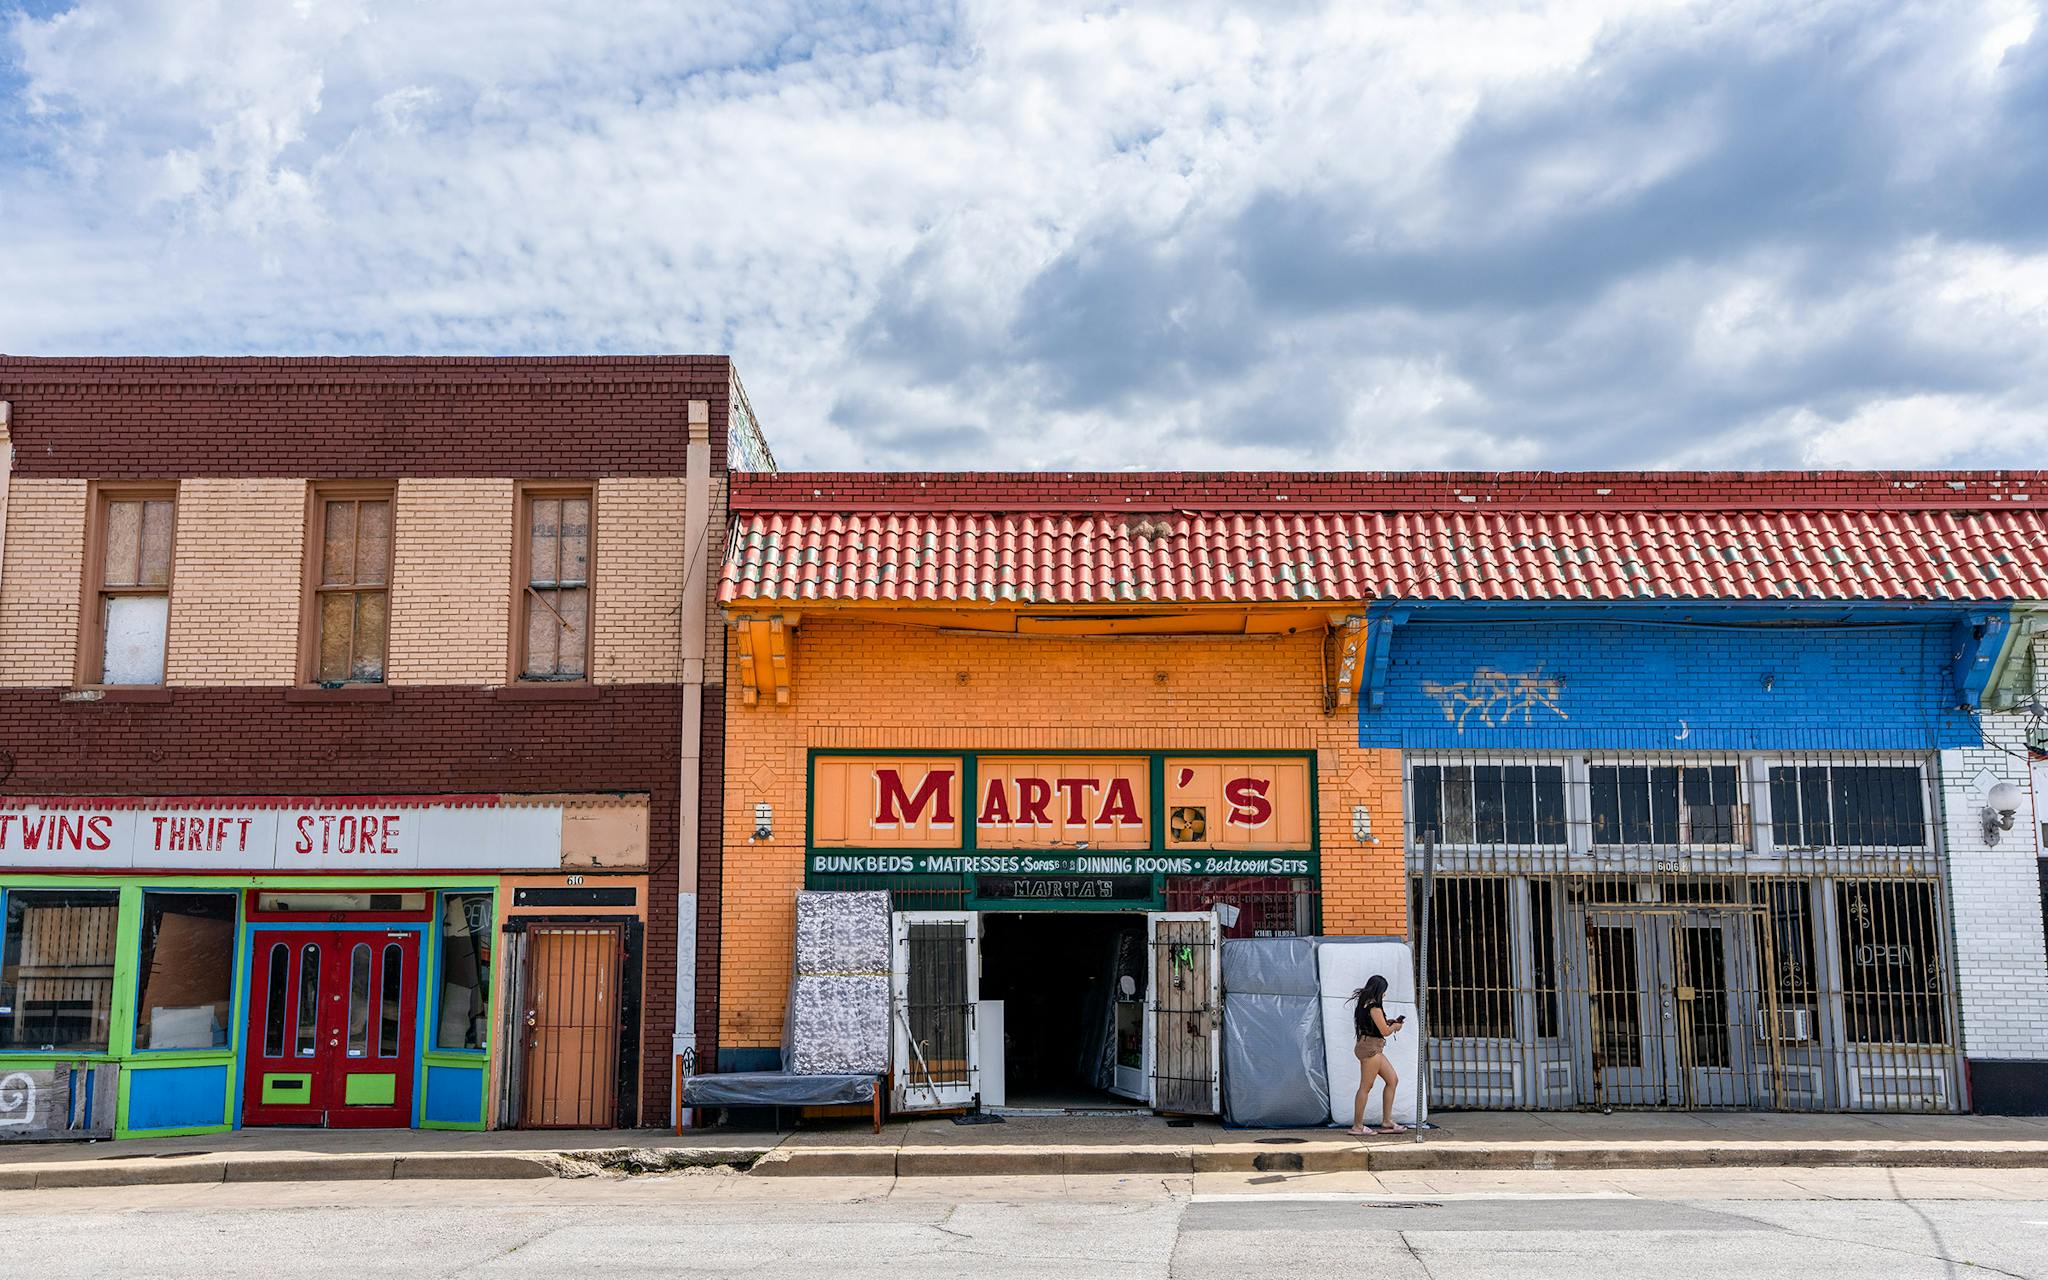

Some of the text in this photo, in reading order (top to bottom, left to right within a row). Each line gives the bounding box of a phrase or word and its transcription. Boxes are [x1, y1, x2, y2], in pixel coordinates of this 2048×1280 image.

[871, 768, 1273, 829] MARTA'S
[0, 815, 400, 854] TWINS THRIFT STORE
[813, 856, 914, 873] BUNKBEDS
[926, 856, 1020, 873] MATRESSES
[1076, 857, 1132, 874] DINNING
[1134, 857, 1192, 874] ROOMS
[1269, 857, 1308, 874] SETS
[566, 875, 584, 886] 610
[464, 904, 492, 928] PEN
[1858, 945, 1914, 965] OPEN
